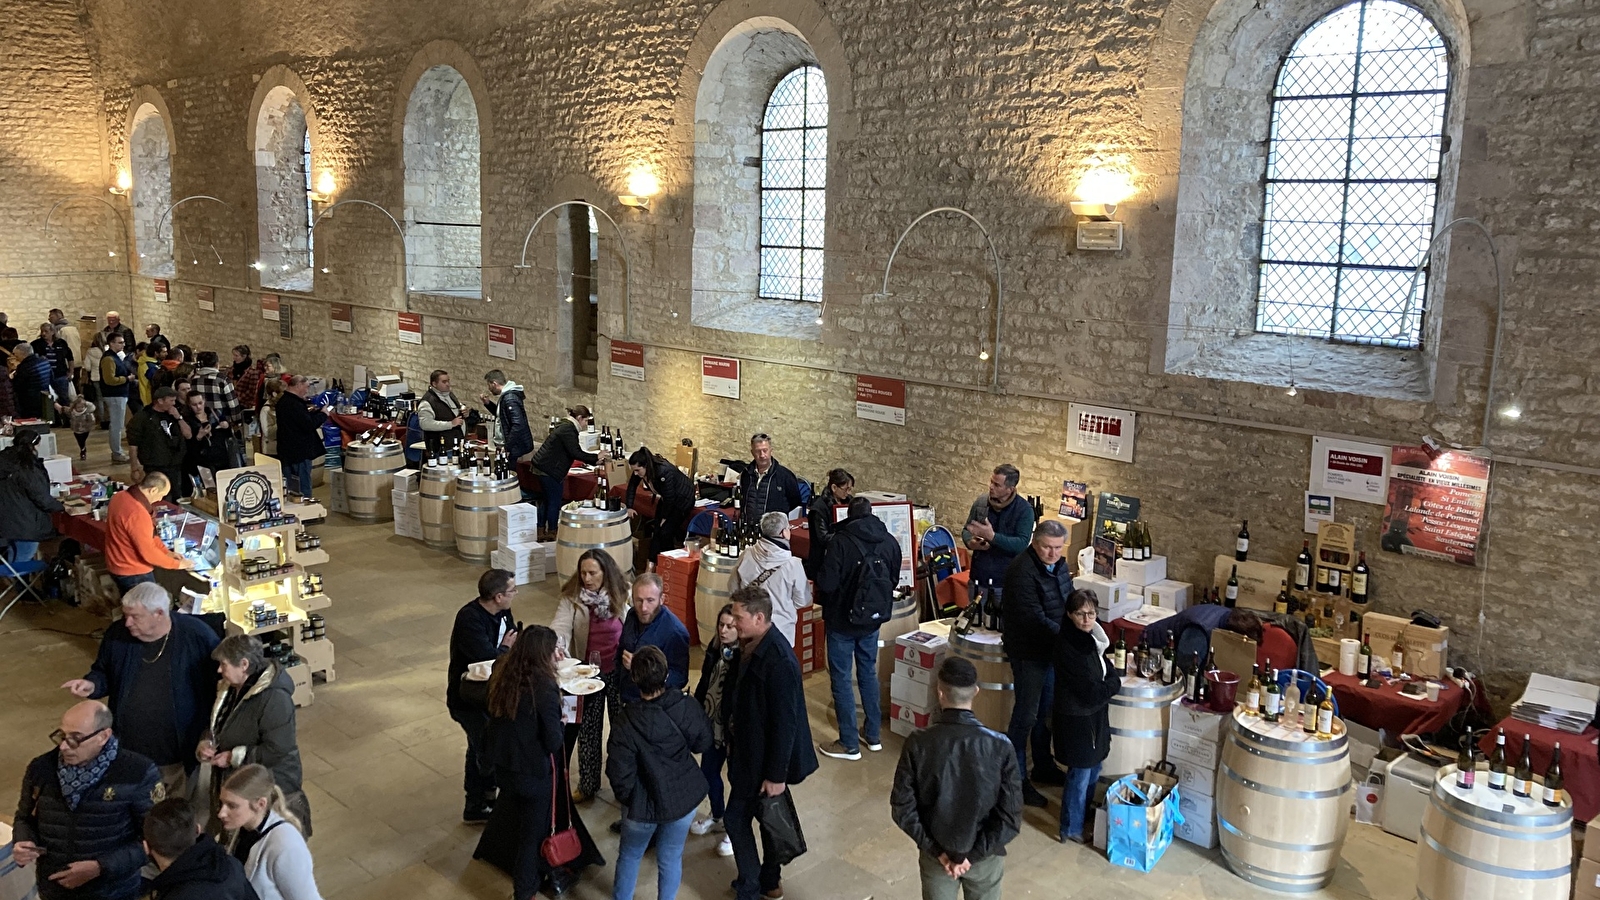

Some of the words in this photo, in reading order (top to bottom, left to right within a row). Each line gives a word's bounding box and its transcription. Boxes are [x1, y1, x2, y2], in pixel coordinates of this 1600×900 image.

[1330, 453, 1347, 461] ALAIN
[1348, 455, 1368, 464] VOISIN
[1419, 470, 1437, 478] ALAIN
[1438, 472, 1460, 481] VOISIN
[1449, 488, 1484, 500] Pomerol
[1404, 505, 1435, 516] Lalande
[1435, 510, 1445, 518] de
[1446, 513, 1480, 525] Pomerol
[1444, 504, 1455, 512] de
[1455, 506, 1481, 518] Bourg
[1423, 525, 1444, 534] Saint
[1435, 536, 1475, 549] Sauternes
[1445, 545, 1473, 557] Graves
